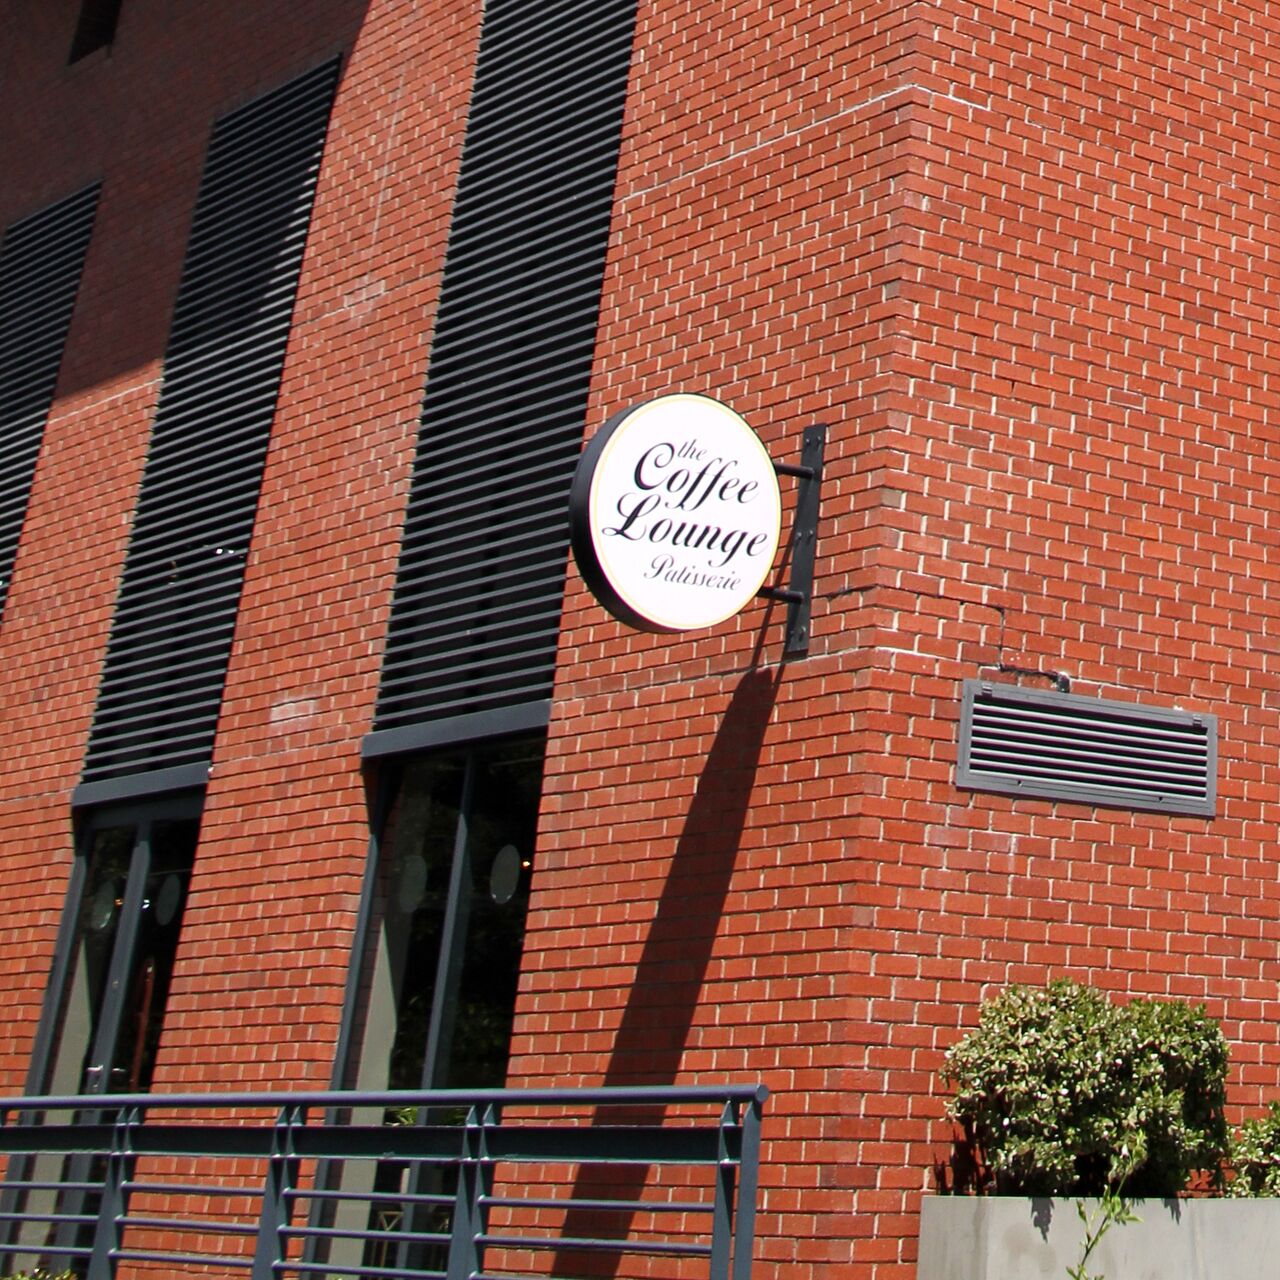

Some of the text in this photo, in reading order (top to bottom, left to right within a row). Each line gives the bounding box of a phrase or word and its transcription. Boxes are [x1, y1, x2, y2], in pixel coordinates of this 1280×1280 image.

[678, 439, 707, 461] the
[635, 443, 759, 511] Coffee
[602, 493, 768, 567] Lounge
[644, 554, 741, 591] Patisserie
